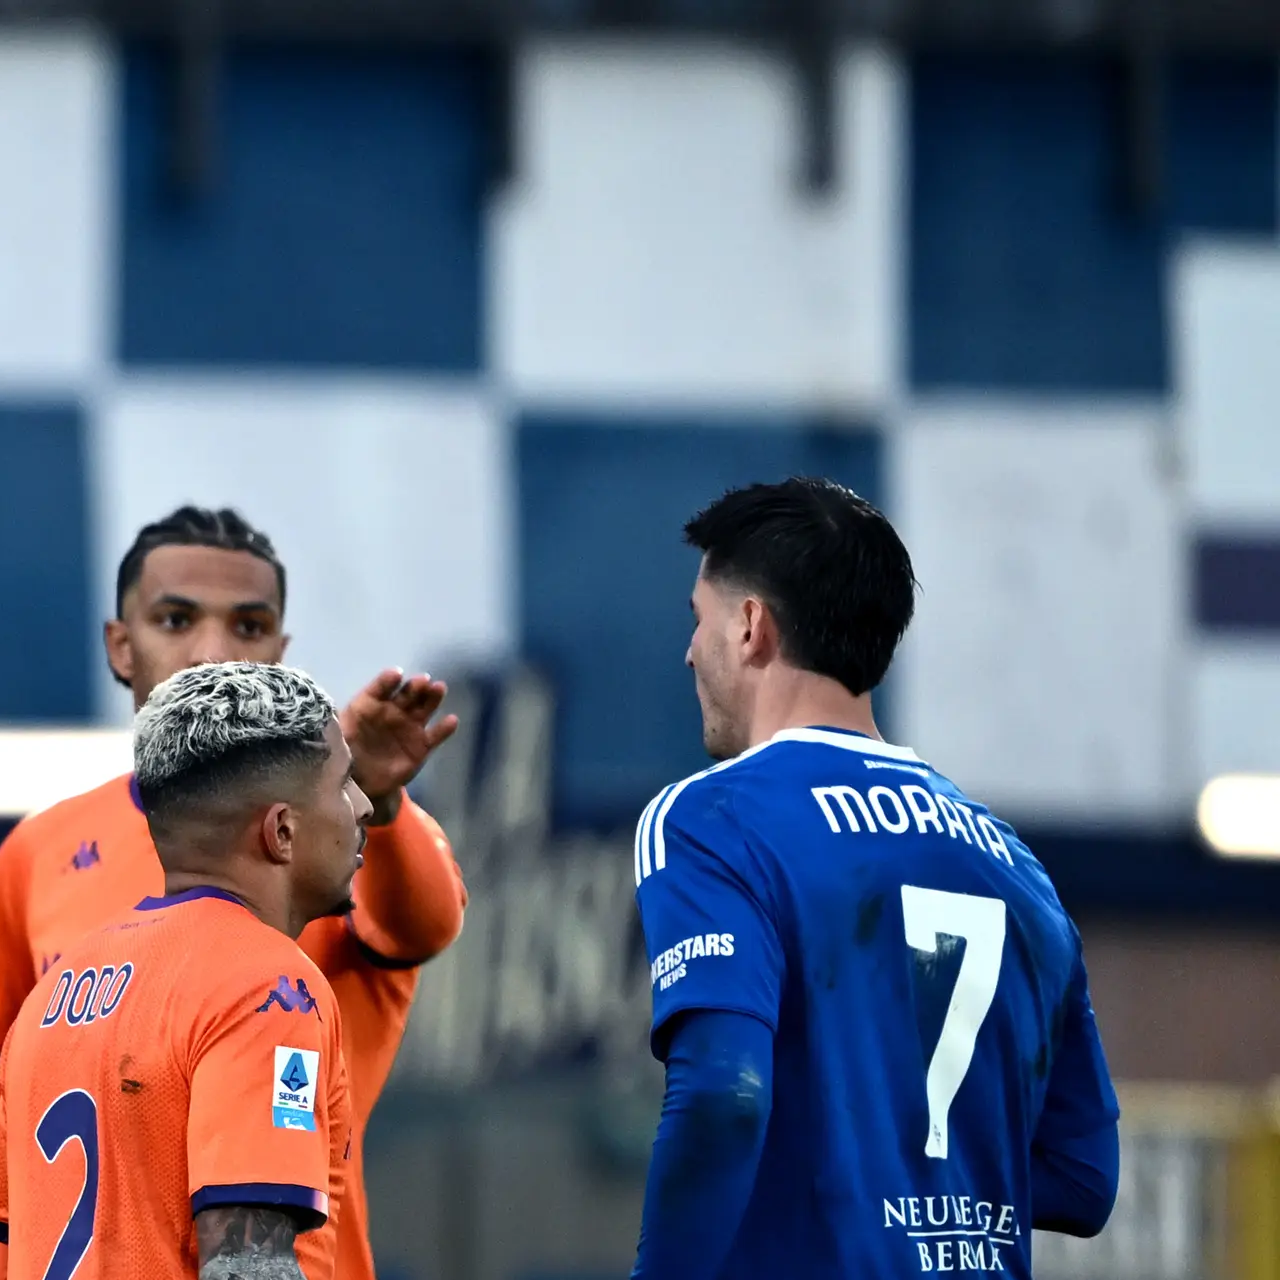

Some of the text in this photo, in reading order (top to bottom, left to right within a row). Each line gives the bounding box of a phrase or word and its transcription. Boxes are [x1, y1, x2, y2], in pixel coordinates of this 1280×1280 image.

[811, 785, 1015, 866] MORATA
[40, 961, 134, 1028] DODO
[659, 962, 687, 992] NEWS
[901, 884, 1006, 1160] 7
